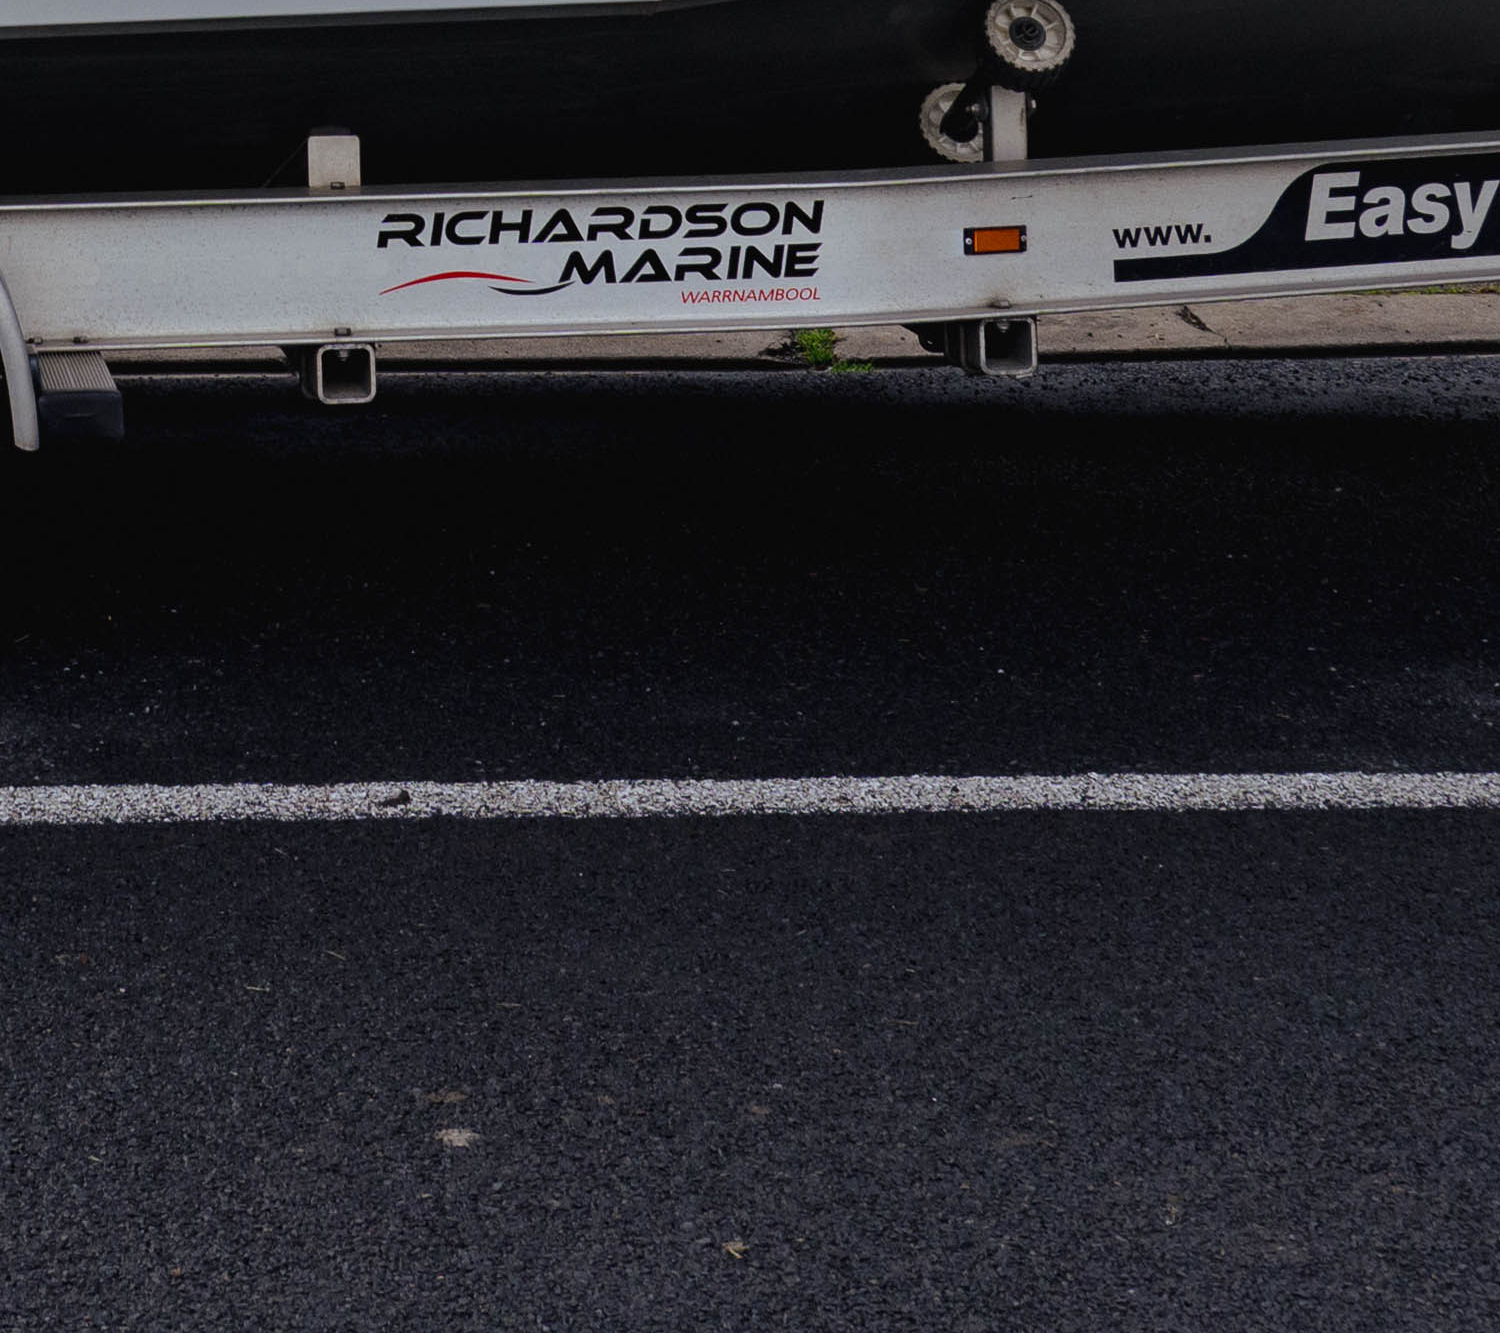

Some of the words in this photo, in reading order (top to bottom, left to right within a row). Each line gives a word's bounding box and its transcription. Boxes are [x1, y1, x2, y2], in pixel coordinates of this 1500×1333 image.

[377, 200, 825, 249] RICHARDSON
[1113, 222, 1212, 249] www.
[559, 242, 823, 285] MARINE
[681, 285, 821, 305] WARRNAMBOOL
